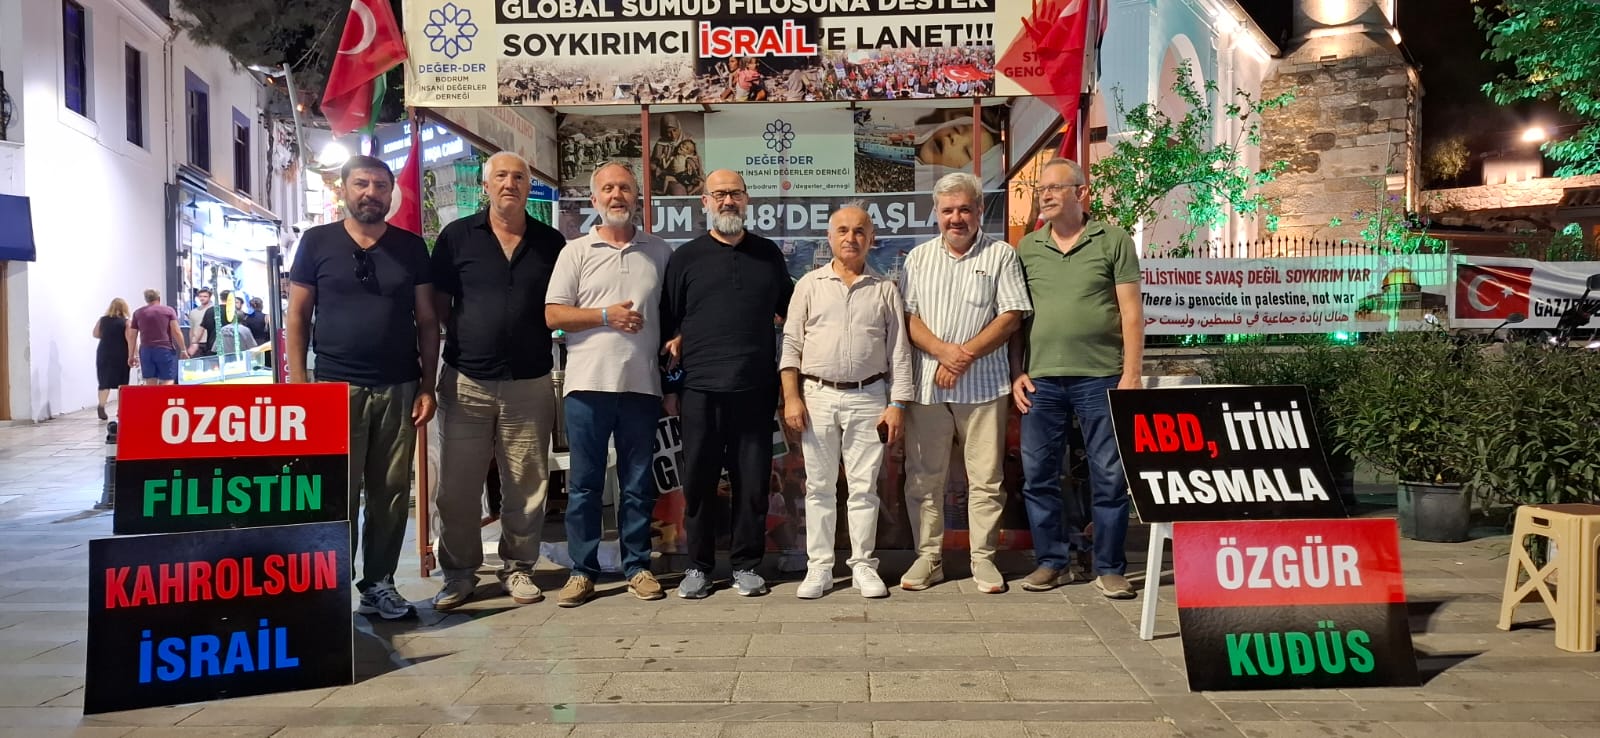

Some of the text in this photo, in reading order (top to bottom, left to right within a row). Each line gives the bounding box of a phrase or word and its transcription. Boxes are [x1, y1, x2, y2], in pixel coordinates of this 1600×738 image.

[501, 0, 615, 19] GLOBAL
[621, 0, 721, 16] SUMUD
[503, 31, 690, 57] SOYKIRIMCI
[856, 23, 993, 50] LANET!!!
[1022, 51, 1040, 62] ST
[418, 62, 487, 74] DEĞER-DER
[1003, 66, 1046, 78] GENO
[435, 75, 469, 83] BODRUM
[435, 92, 470, 100] DERNEĞİ
[745, 154, 814, 165] DEĞER-DER
[773, 168, 814, 176] DEĞERLER
[1205, 270, 1244, 288] SAVAŞ
[1247, 266, 1282, 285] DEĞİL
[1286, 268, 1344, 284] SOYKIRIM
[1347, 268, 1371, 283] VAR
[1141, 291, 1355, 309] There is genocide in palestine, not war
[1246, 311, 1260, 327] في
[1262, 311, 1298, 326] جماعية
[1324, 310, 1349, 323] هناك
[161, 397, 307, 444] ÖZGÜR
[1133, 400, 1310, 458] ABD, İTİNİ
[143, 466, 322, 517] FİLİSTİN
[1139, 467, 1330, 505] TASMALA
[1215, 536, 1363, 590] ÖZGÜR
[105, 550, 337, 609] KAHROLSUN
[138, 618, 299, 684] İSRAİL
[1225, 620, 1375, 676] KUDÜS
